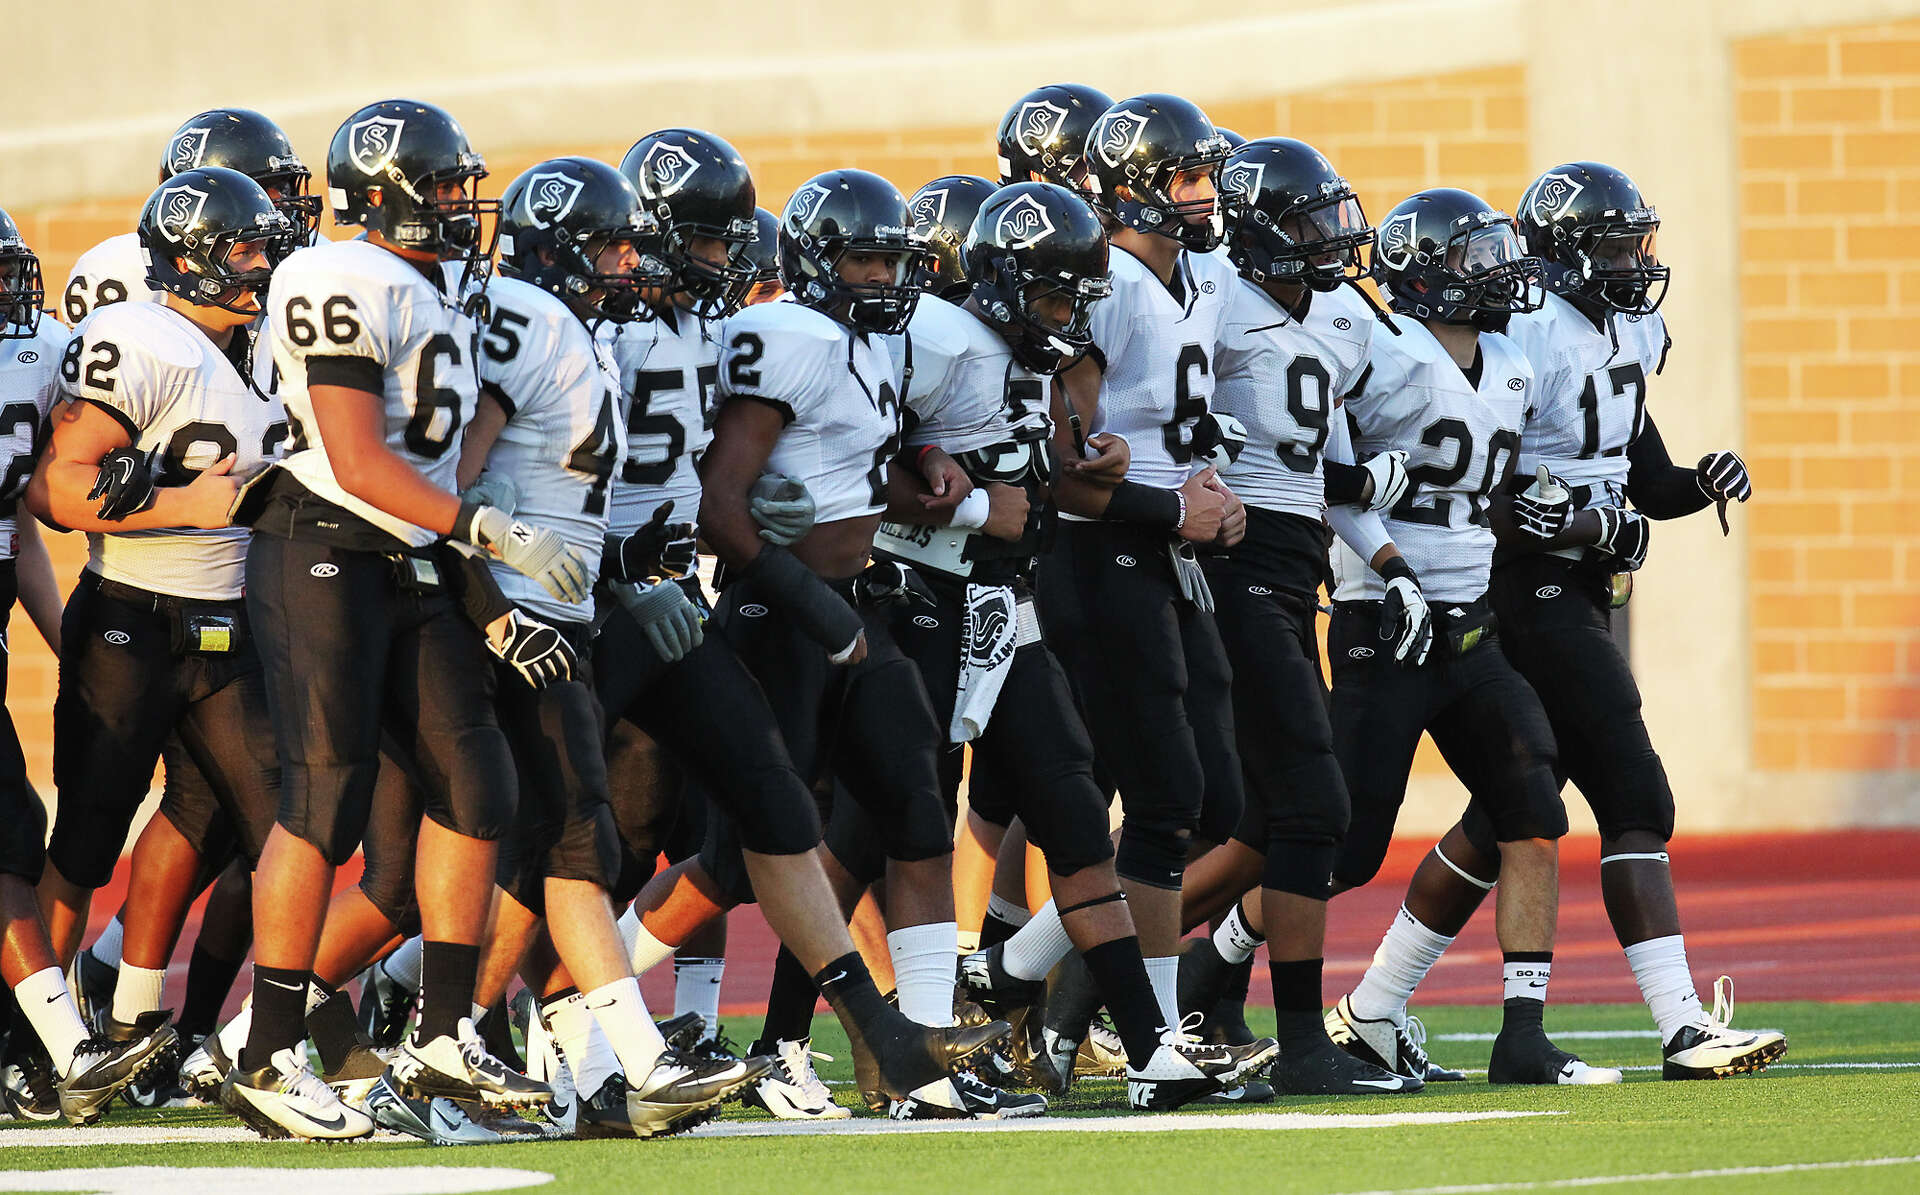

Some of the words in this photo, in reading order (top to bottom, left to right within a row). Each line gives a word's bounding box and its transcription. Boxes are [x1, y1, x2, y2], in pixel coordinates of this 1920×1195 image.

[61, 336, 120, 391] 82
[286, 296, 360, 347] 66
[728, 331, 765, 388] 2
[1162, 341, 1209, 465] 6
[1275, 353, 1330, 474] 9
[1578, 361, 1646, 459] 17
[1390, 416, 1522, 528] 20
